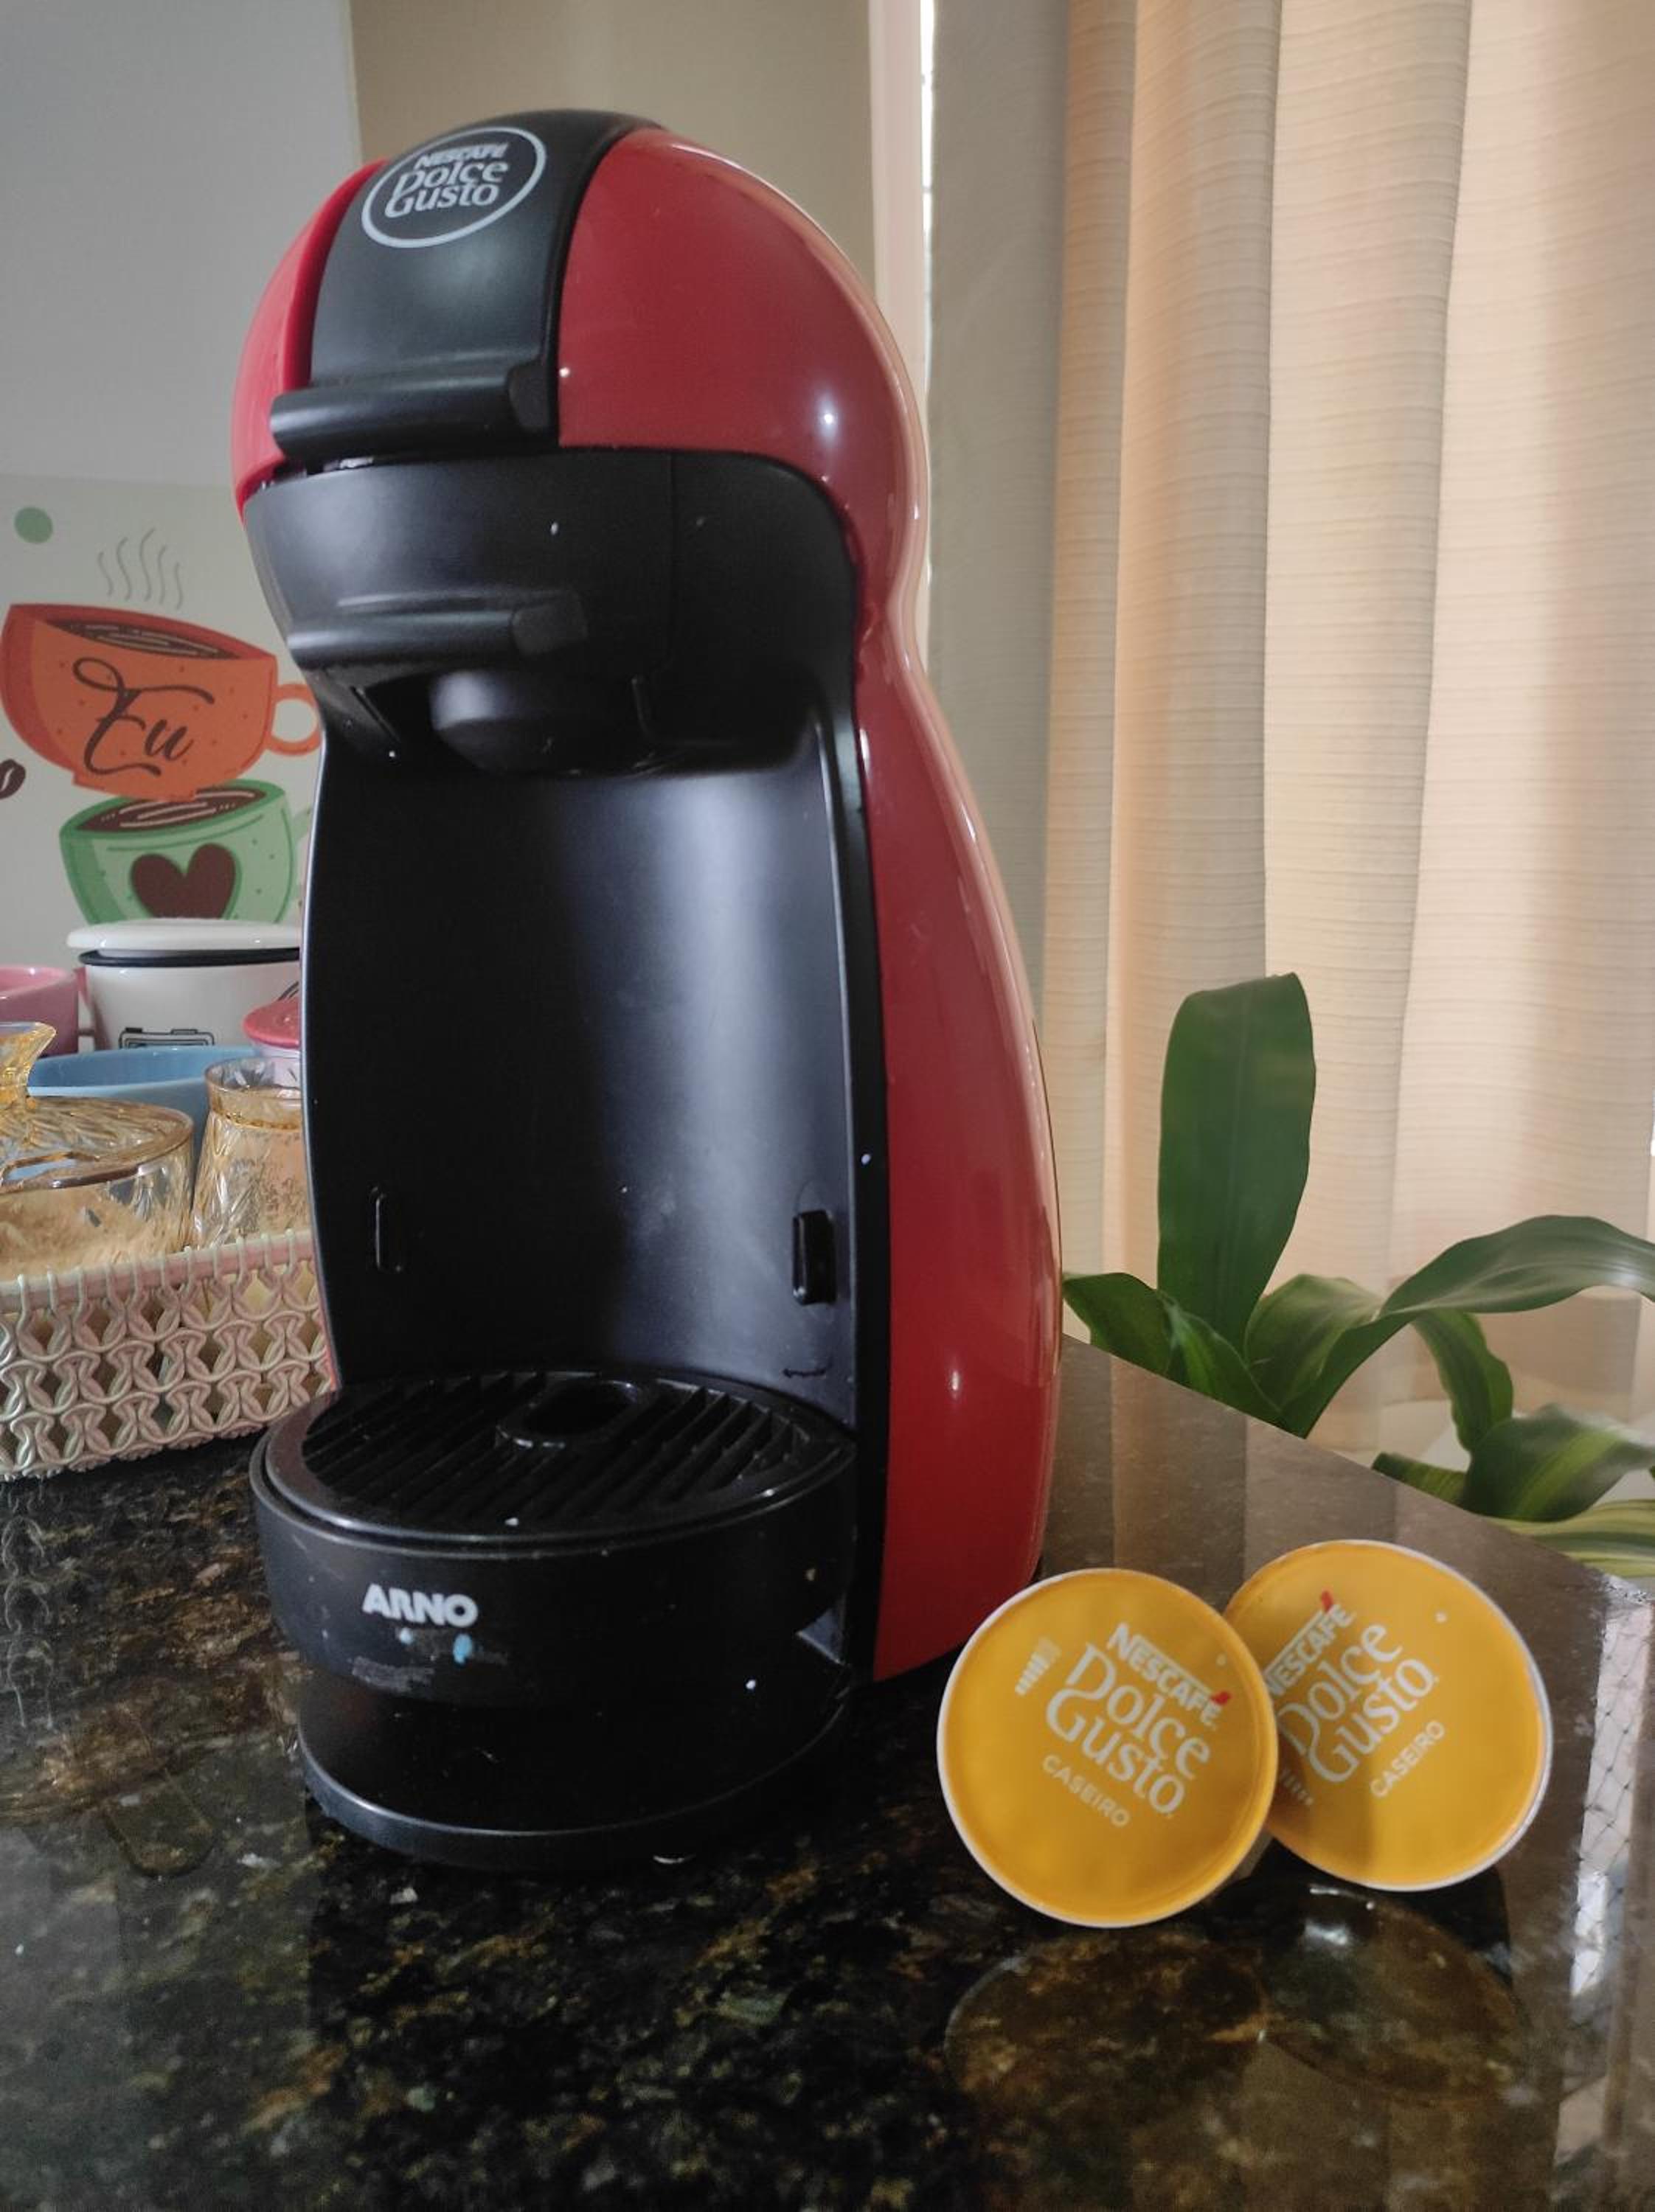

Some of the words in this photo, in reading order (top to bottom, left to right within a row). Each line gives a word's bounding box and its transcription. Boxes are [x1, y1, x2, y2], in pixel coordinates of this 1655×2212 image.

[384, 181, 499, 218] Gusto
[392, 161, 509, 198] Dolce
[362, 1583, 478, 1627] ARNO
[1065, 1641, 1210, 1779] Dolce
[1308, 1659, 1436, 1782] Gusto
[1046, 1688, 1185, 1815] Gusto
[1370, 1720, 1446, 1798] CASEIRO
[1042, 1755, 1131, 1827] CASEIRO
